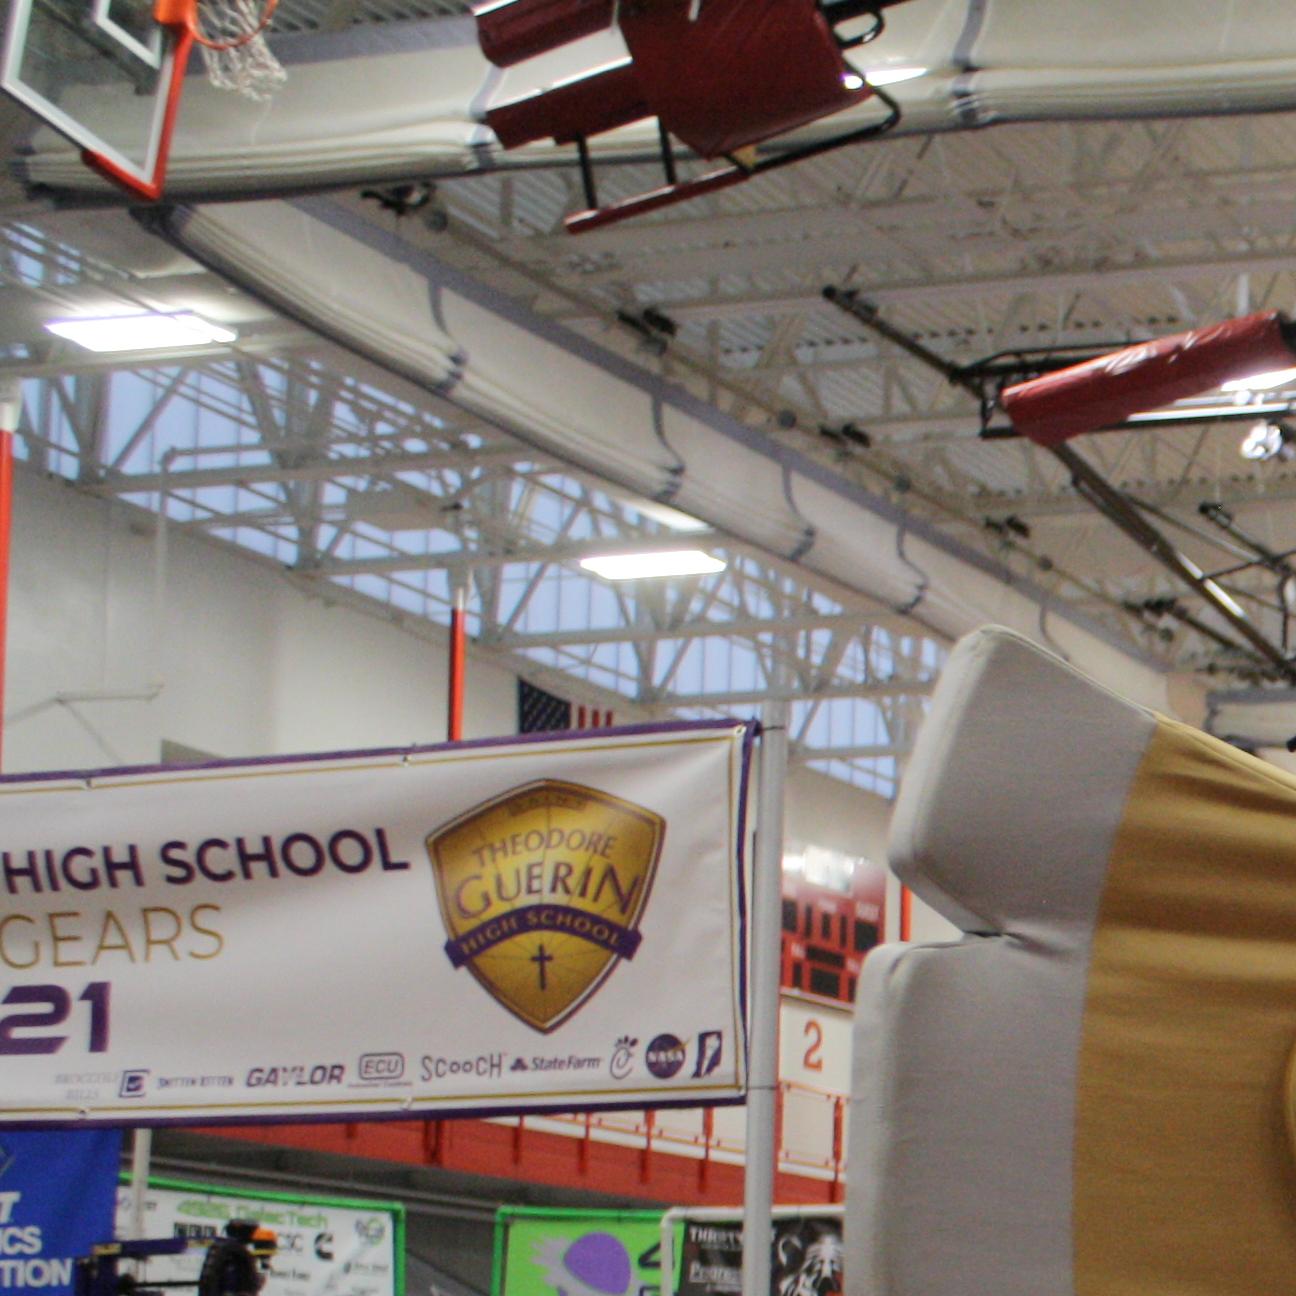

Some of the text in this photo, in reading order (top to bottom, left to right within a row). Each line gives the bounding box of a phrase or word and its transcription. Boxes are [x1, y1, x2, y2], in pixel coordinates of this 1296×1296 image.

[2, 828, 411, 894] HIGH SCHOOL
[472, 828, 617, 868] THEODORE
[456, 861, 640, 919] GUERIN
[0, 903, 224, 969] GEARS
[462, 910, 620, 955] HIGH SCHOOL
[0, 981, 111, 1055] 21
[364, 1058, 400, 1075] ECU
[803, 1020, 823, 1073] 2
